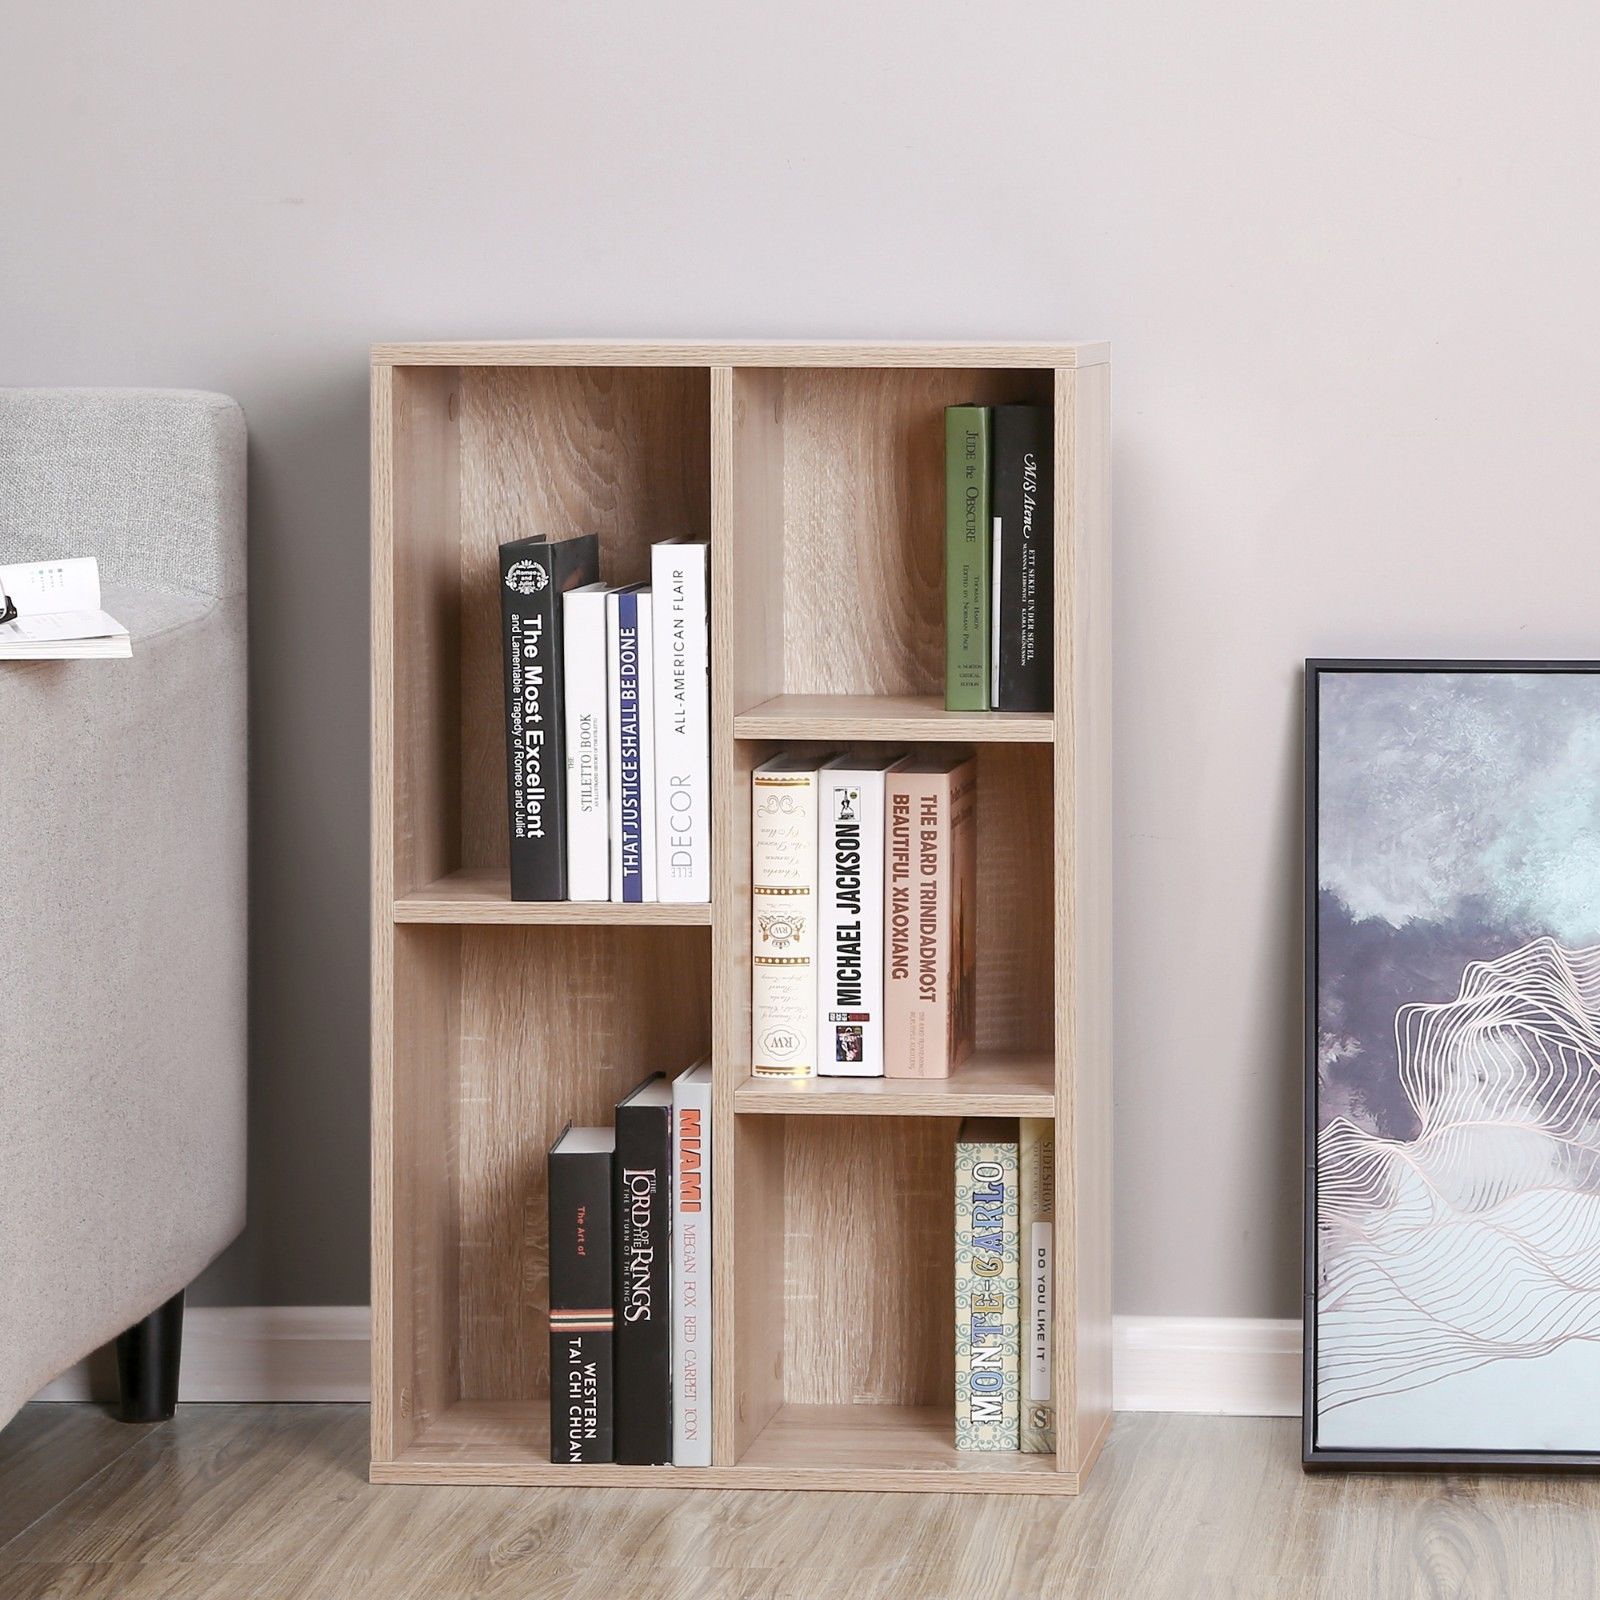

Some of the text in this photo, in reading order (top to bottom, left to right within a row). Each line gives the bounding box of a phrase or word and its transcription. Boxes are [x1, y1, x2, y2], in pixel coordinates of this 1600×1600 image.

[966, 465, 977, 479] the
[1023, 453, 1037, 539] M/S Atene
[672, 569, 685, 735] ALL-AMERICAN FLAIR
[1027, 632, 1035, 661] SEGEL
[510, 614, 526, 838] and Lamentable Tragedy of Romeo and Juliet
[524, 614, 546, 839] The Most Excellent
[580, 714, 592, 812] STILETTO BOOK
[620, 628, 639, 877] THAT JUSTICE SHALL BE DONE
[670, 774, 693, 867] DECOR
[835, 824, 861, 915] JACKSON
[892, 794, 910, 980] BEAUTIFUL XIAOXIANG
[919, 794, 938, 1003] THE BARD TRINIDADMOST
[836, 920, 861, 1006] MICHAEL
[623, 1167, 656, 1228] LORD
[680, 1109, 702, 1213] MIAMI
[1043, 1141, 1052, 1214] SIDESHOW
[577, 1206, 586, 1256] The Art of
[624, 1245, 630, 1255] OF
[633, 1227, 641, 1248] THE
[641, 1230, 649, 1245] OF
[1038, 1248, 1046, 1269] DO
[623, 1246, 654, 1322] RINGS
[970, 1162, 1004, 1424] MONTE-CARLO
[1037, 1309, 1045, 1341] LIKE
[1038, 1274, 1046, 1304] YOU
[684, 1223, 697, 1441] MEGAN FOX RED CARPET ICON
[1037, 1346, 1045, 1361] IT
[569, 1337, 582, 1463] TAI CHI CHUAN
[584, 1361, 597, 1439] WESTERN
